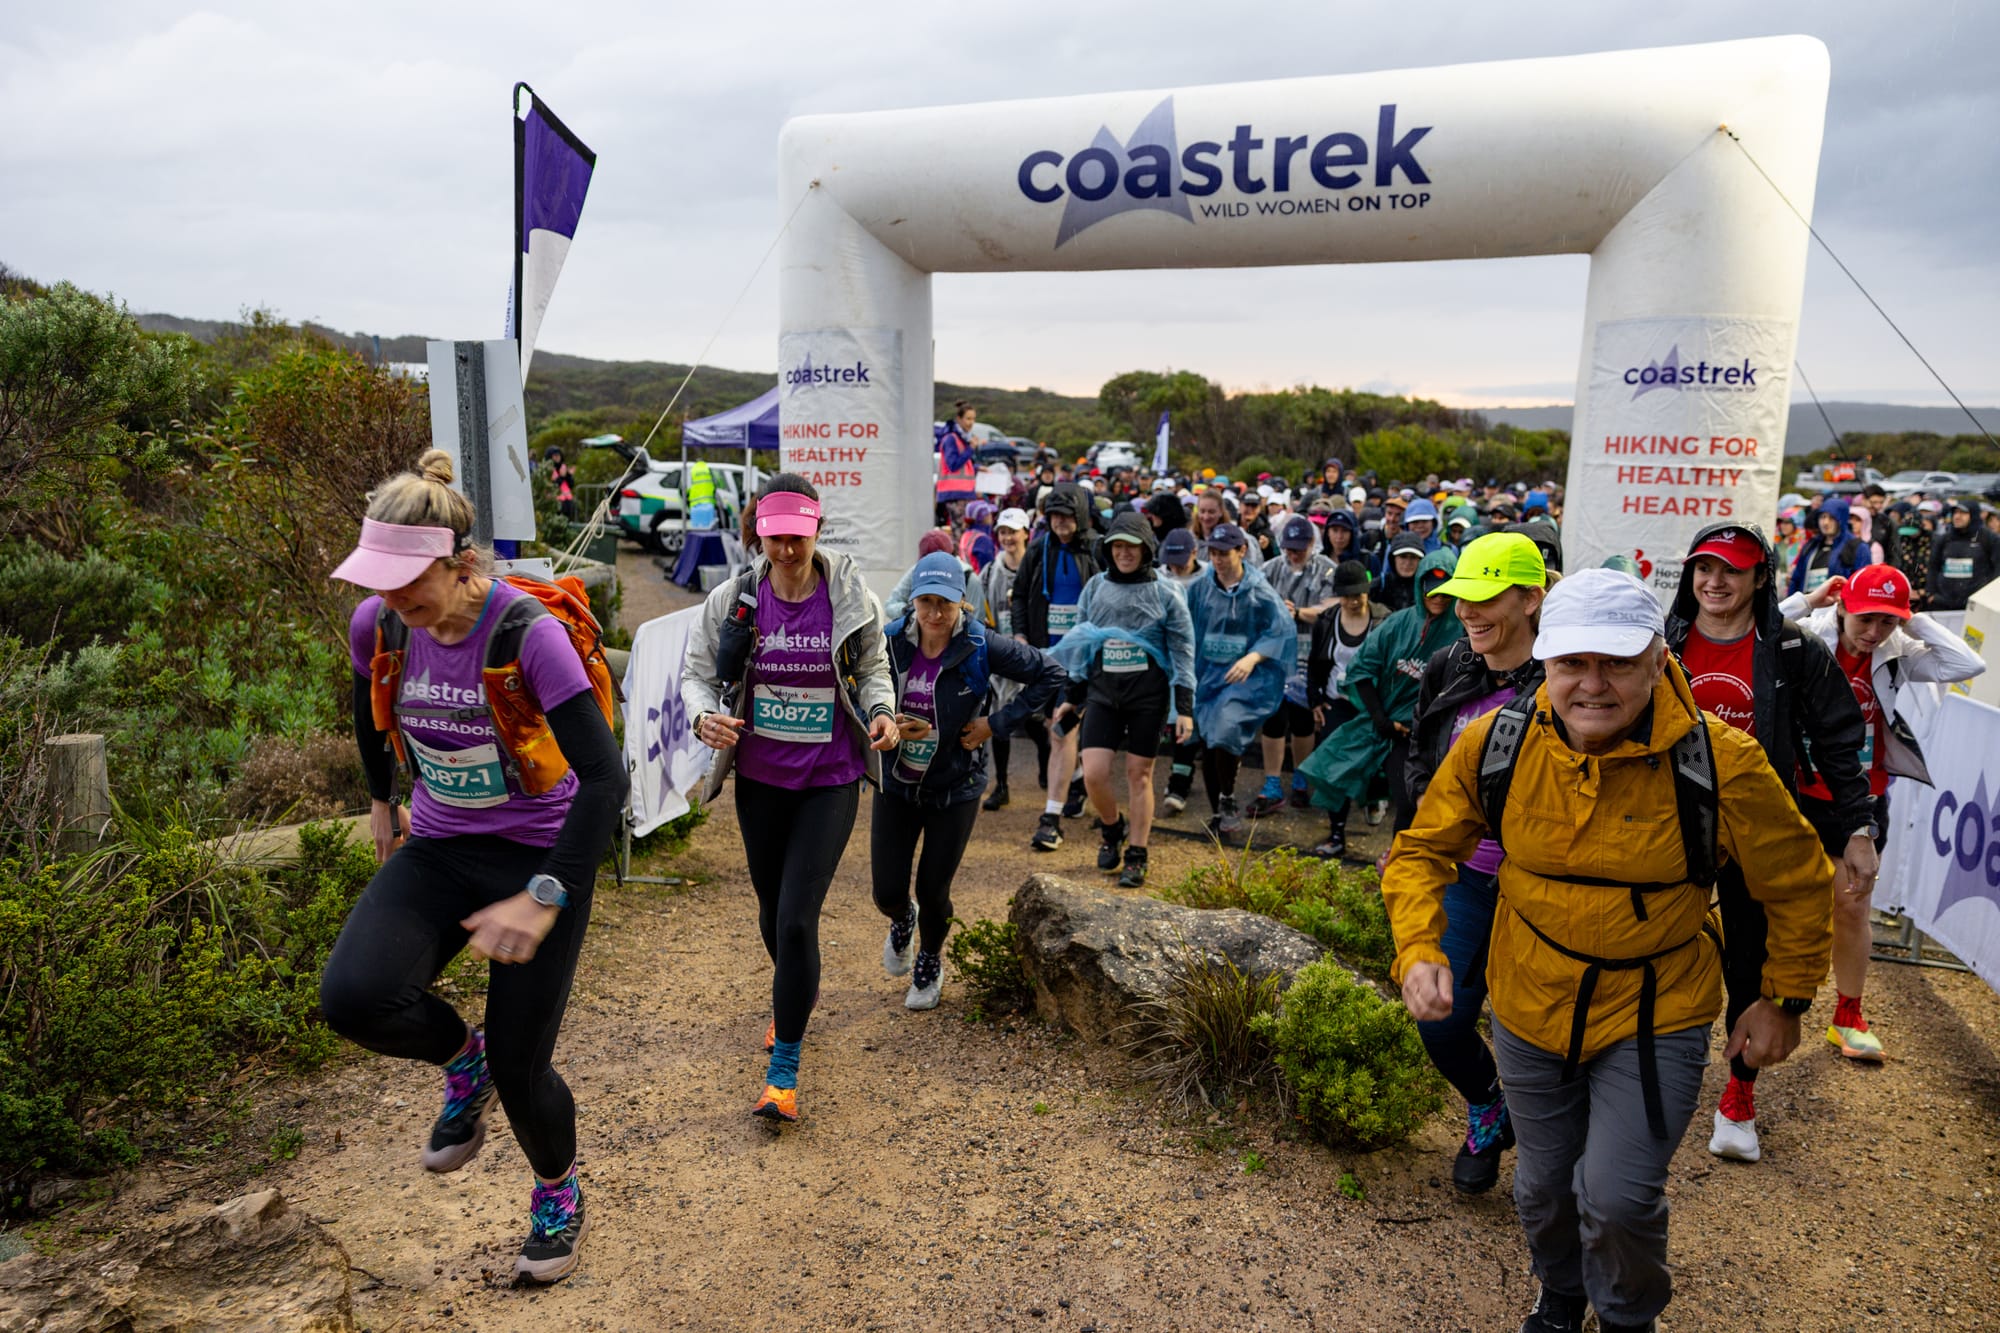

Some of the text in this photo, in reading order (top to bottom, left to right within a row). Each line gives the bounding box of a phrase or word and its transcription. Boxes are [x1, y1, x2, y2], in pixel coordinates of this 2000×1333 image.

[1017, 104, 1434, 204] coastrek
[1200, 193, 1432, 217] WILD WOMEN ON TOP
[786, 361, 870, 384] coastrek
[1624, 358, 1758, 385] coastrek
[783, 423, 879, 439] HIKING FOR
[789, 447, 867, 462] HEALTHY
[1604, 435, 1758, 457] HIKING FOR
[799, 471, 862, 486] EARTS
[1617, 465, 1744, 487] HEALTHY
[1622, 496, 1734, 517] HEARTS
[1655, 567, 1680, 578] Hea
[758, 631, 831, 648] coastrek
[755, 662, 832, 673] AMBASSADOR
[759, 702, 828, 722] 3087-2
[1715, 703, 1755, 720] Hear
[400, 715, 496, 736] MBASSADOR
[421, 763, 492, 787] 087-1
